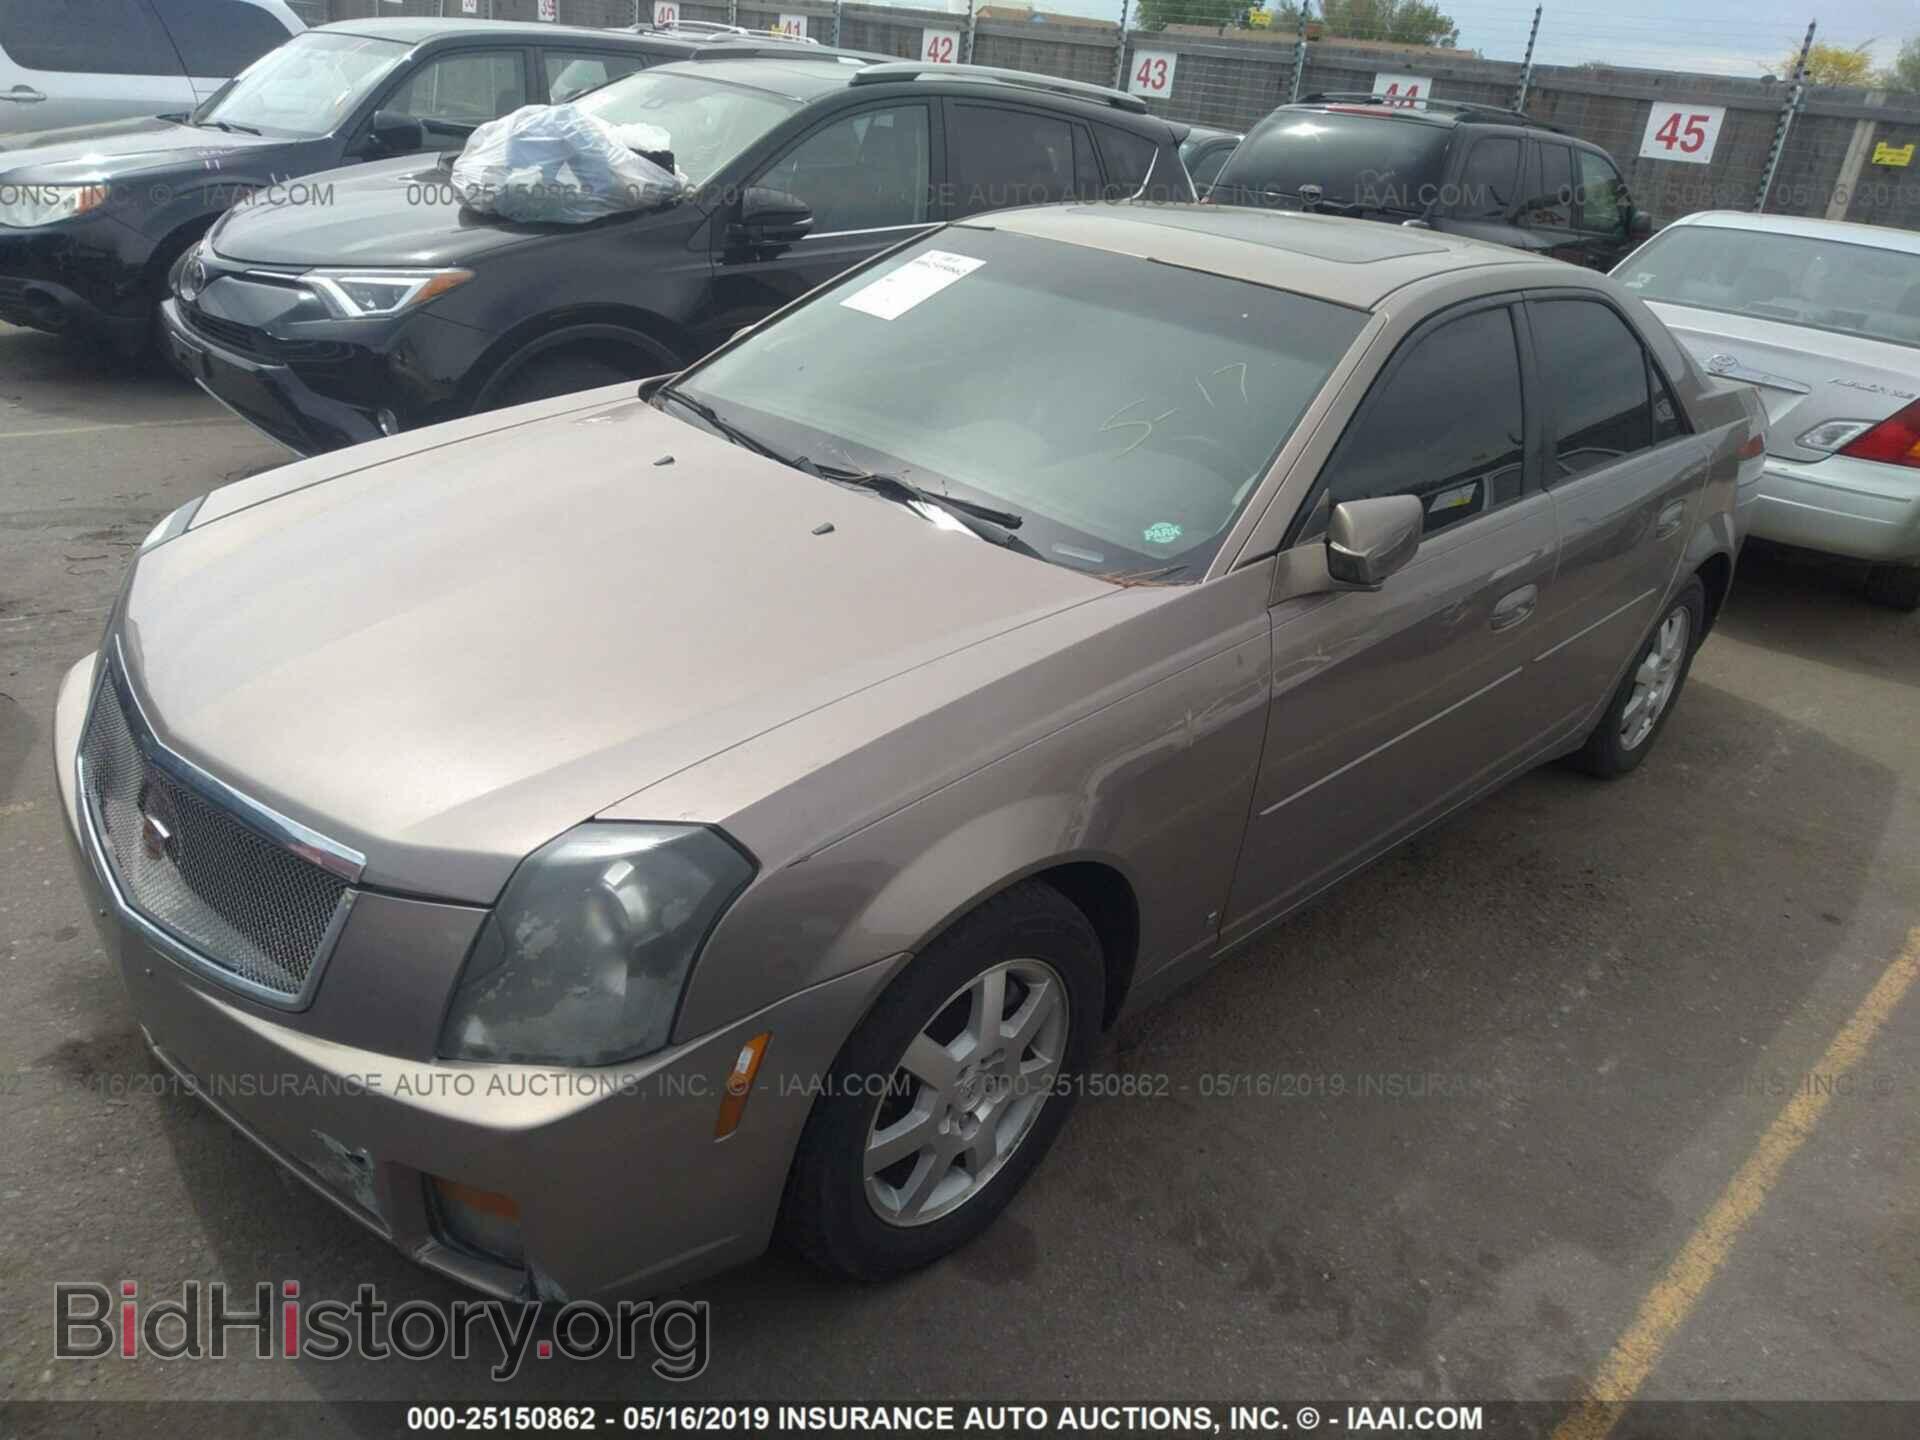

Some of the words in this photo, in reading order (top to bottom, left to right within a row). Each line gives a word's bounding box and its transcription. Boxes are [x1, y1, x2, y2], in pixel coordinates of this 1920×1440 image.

[927, 36, 953, 63] 42
[1136, 58, 1168, 90] 43
[1655, 112, 1710, 153] 45
[1143, 526, 1182, 541] PARK
